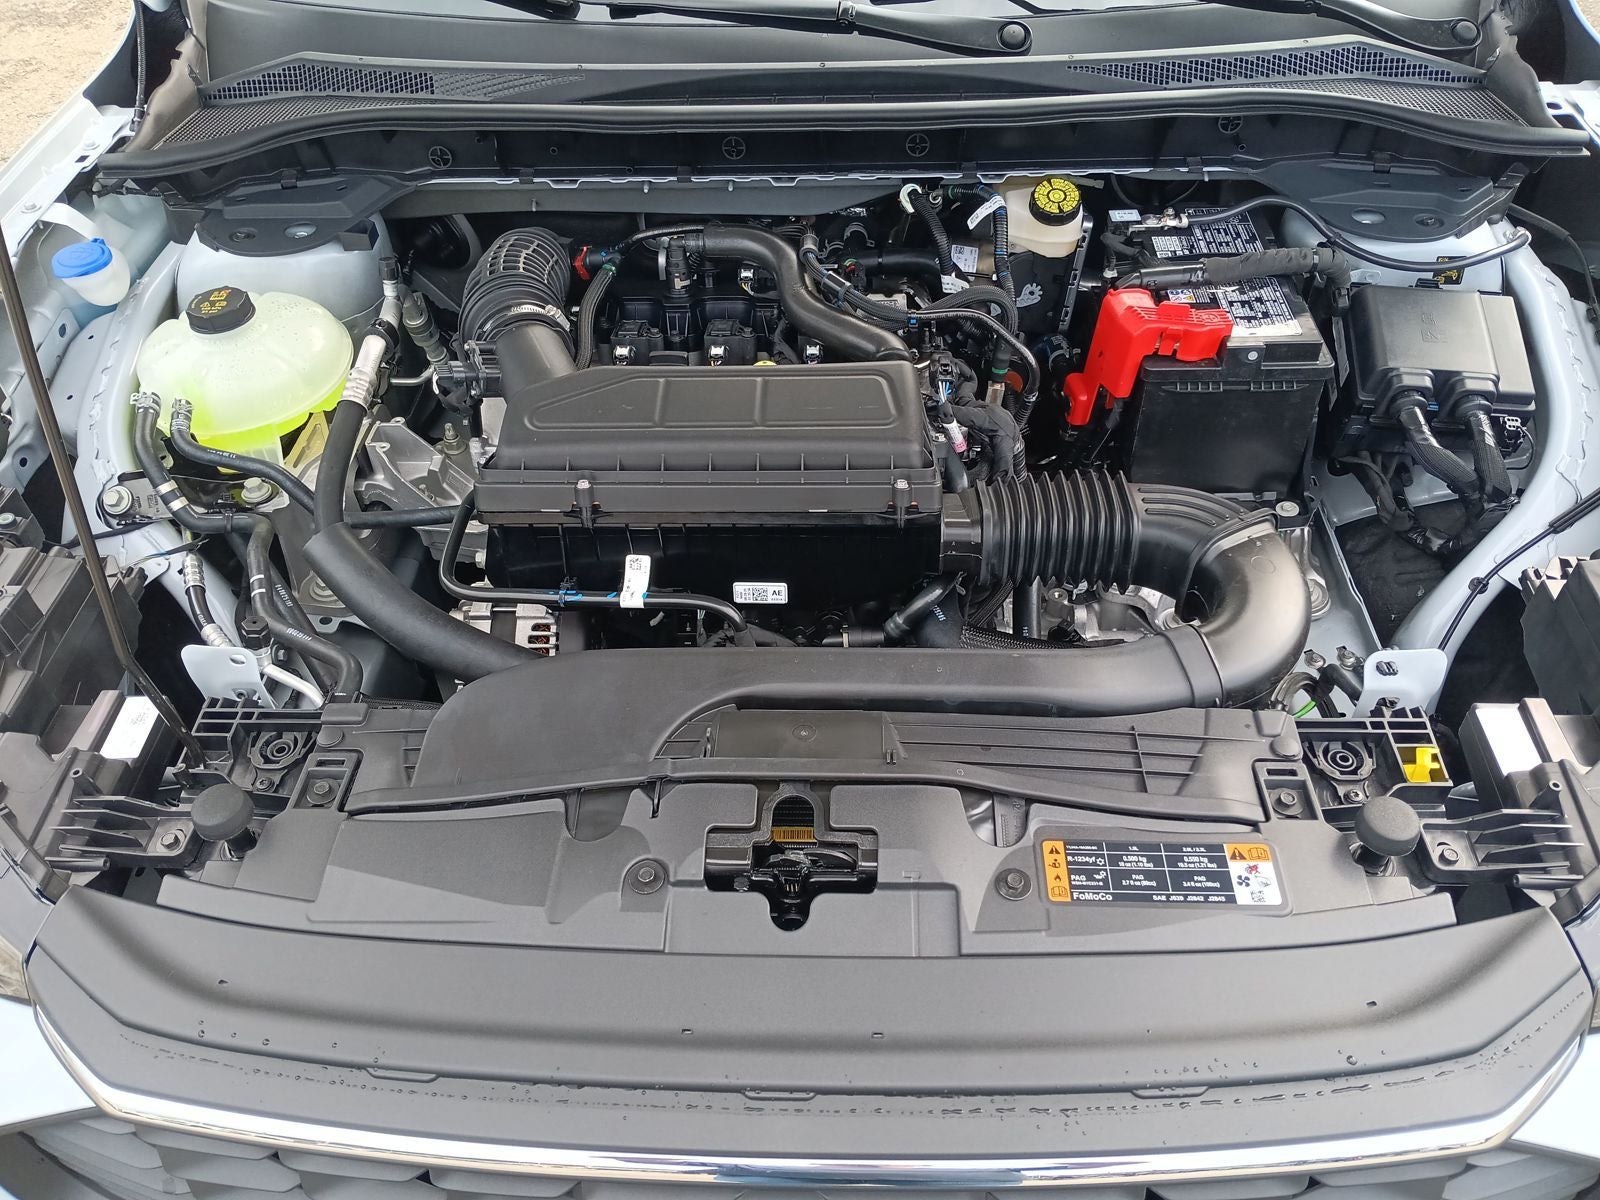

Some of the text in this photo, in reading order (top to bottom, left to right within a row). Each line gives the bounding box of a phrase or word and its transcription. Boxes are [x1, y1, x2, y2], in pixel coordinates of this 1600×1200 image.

[772, 589, 783, 597] AE
[1067, 855, 1095, 863] R-1234yf
[1073, 892, 1113, 901] FoMoCo
